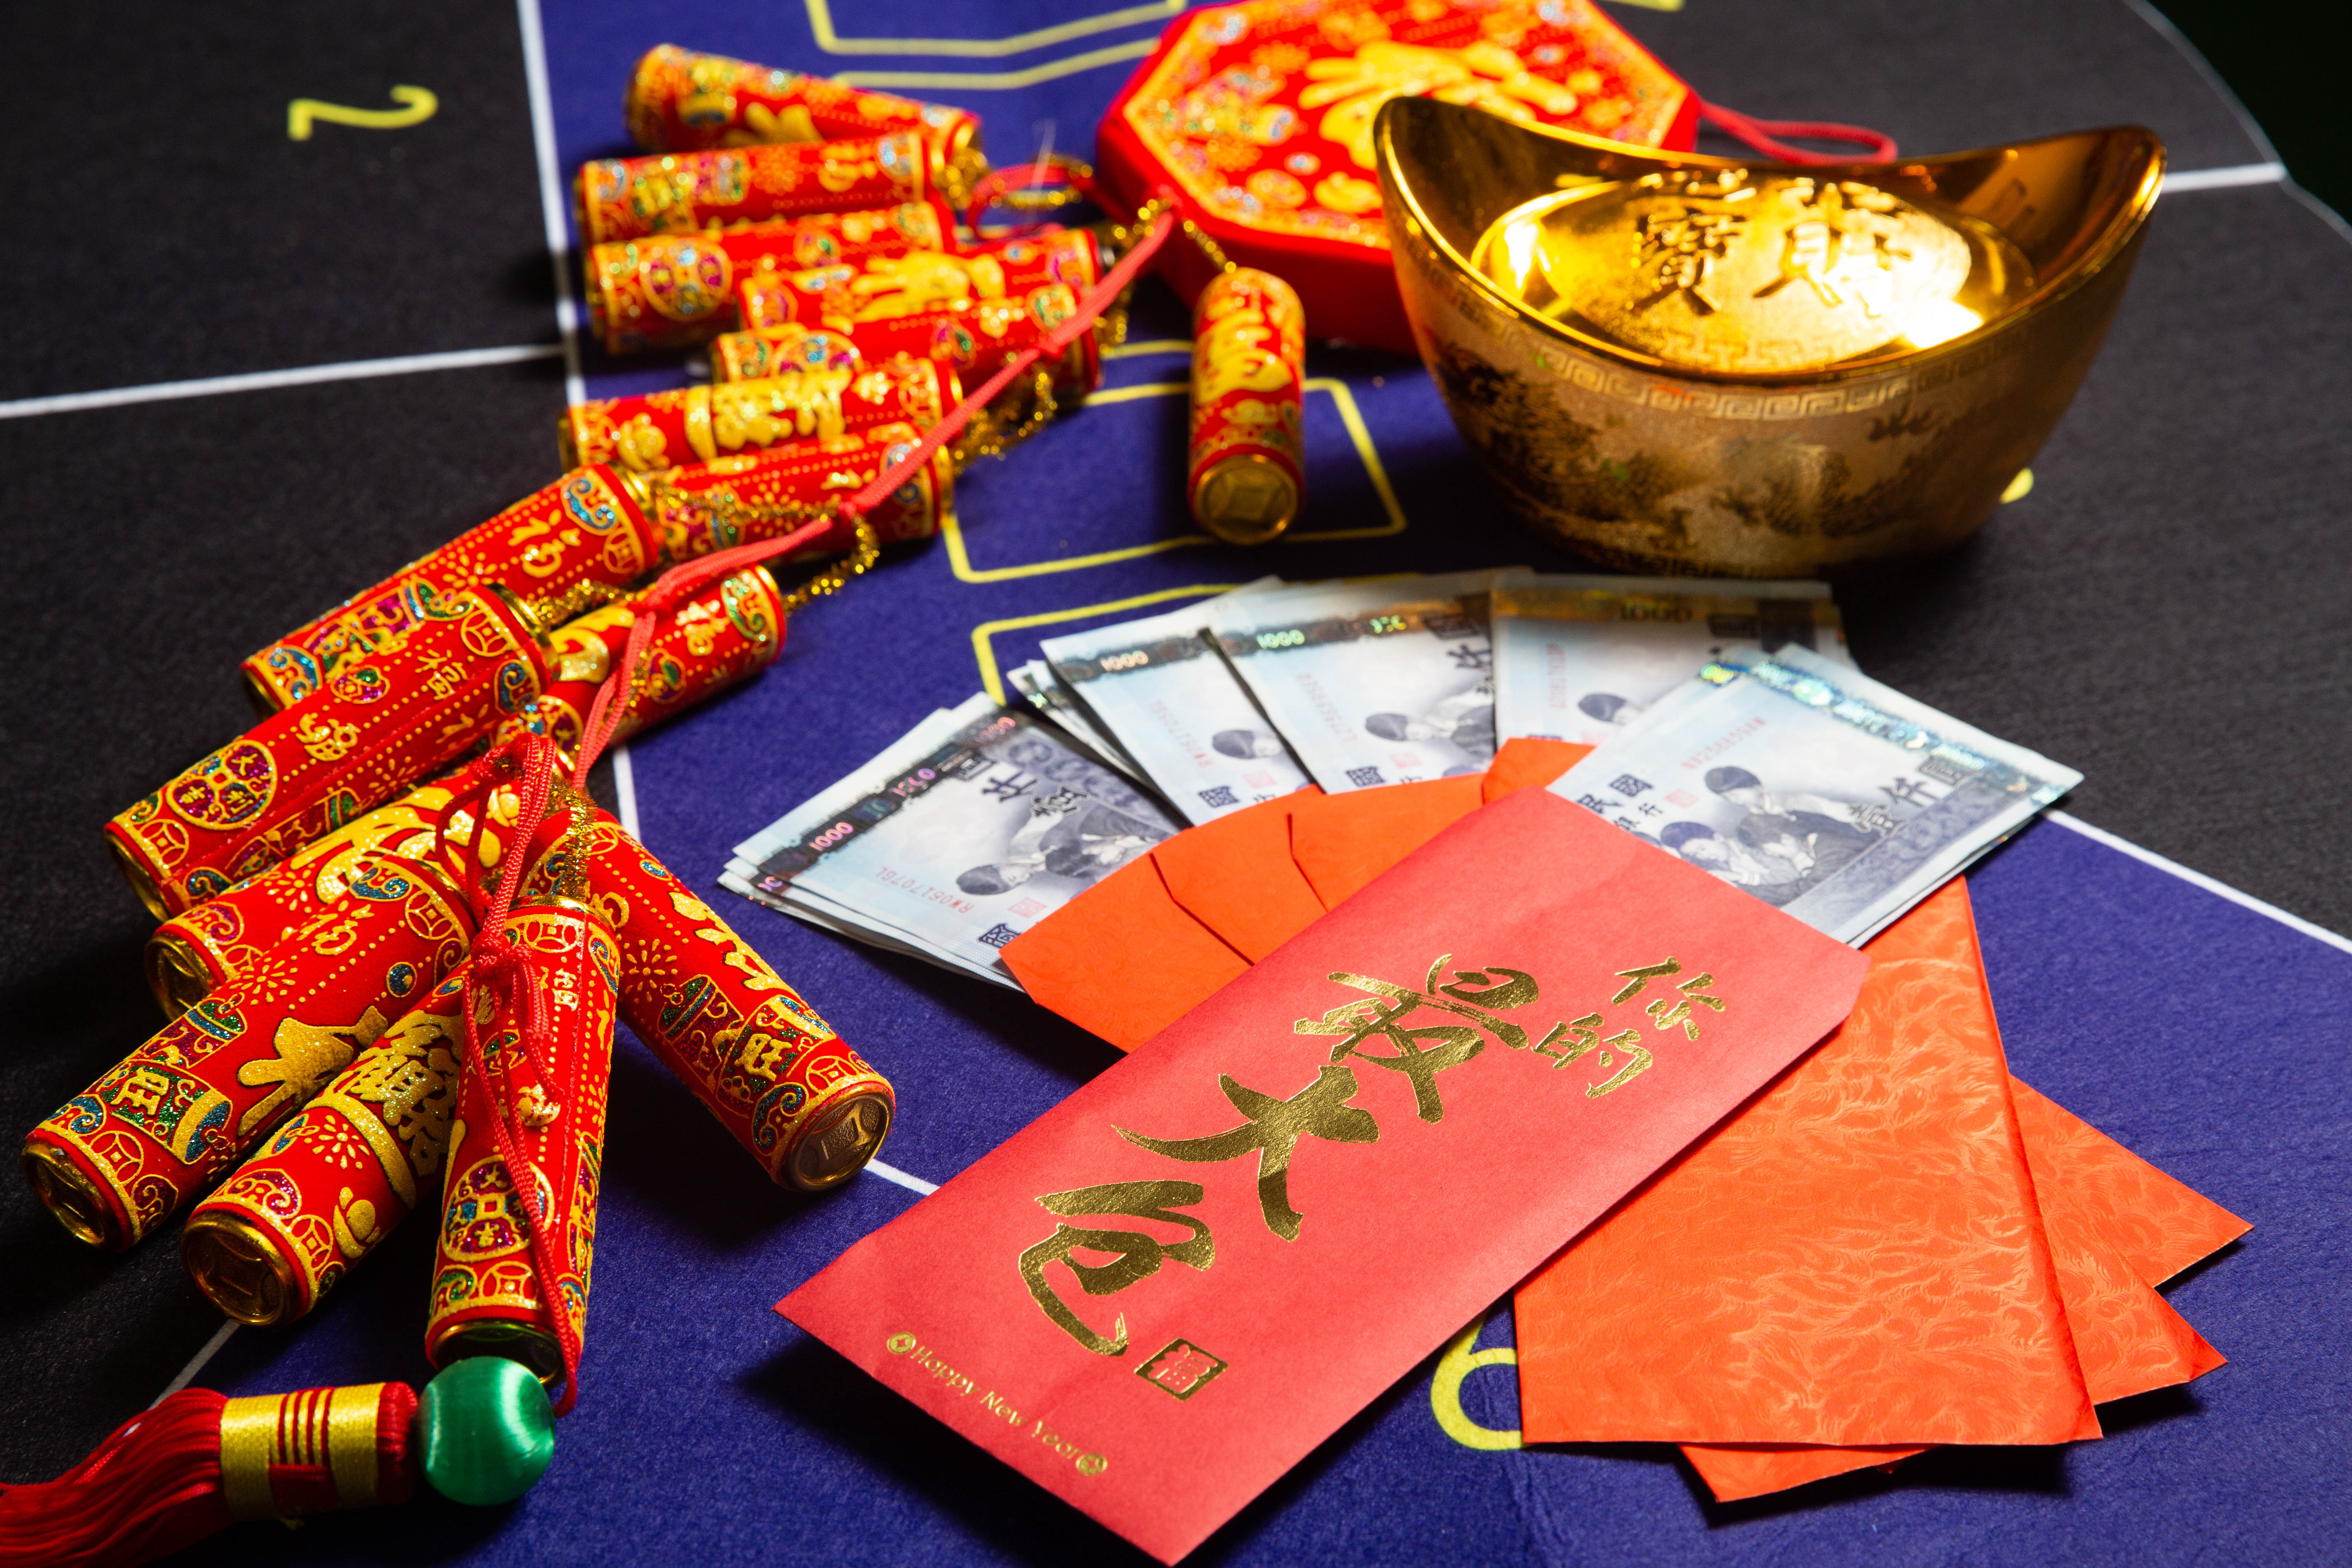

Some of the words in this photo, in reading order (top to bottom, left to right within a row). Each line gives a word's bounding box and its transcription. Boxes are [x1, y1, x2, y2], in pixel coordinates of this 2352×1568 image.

[287, 84, 439, 142] 2
[416, 649, 469, 700] 福
[1101, 650, 1149, 673] 1000
[810, 820, 854, 852] 1000
[1531, 956, 1726, 1099] 你的
[735, 1032, 793, 1082] 旺
[113, 1069, 169, 1118] 旺
[910, 1345, 982, 1396] Happy
[980, 1390, 1030, 1427] New
[1031, 1420, 1082, 1459] Year
